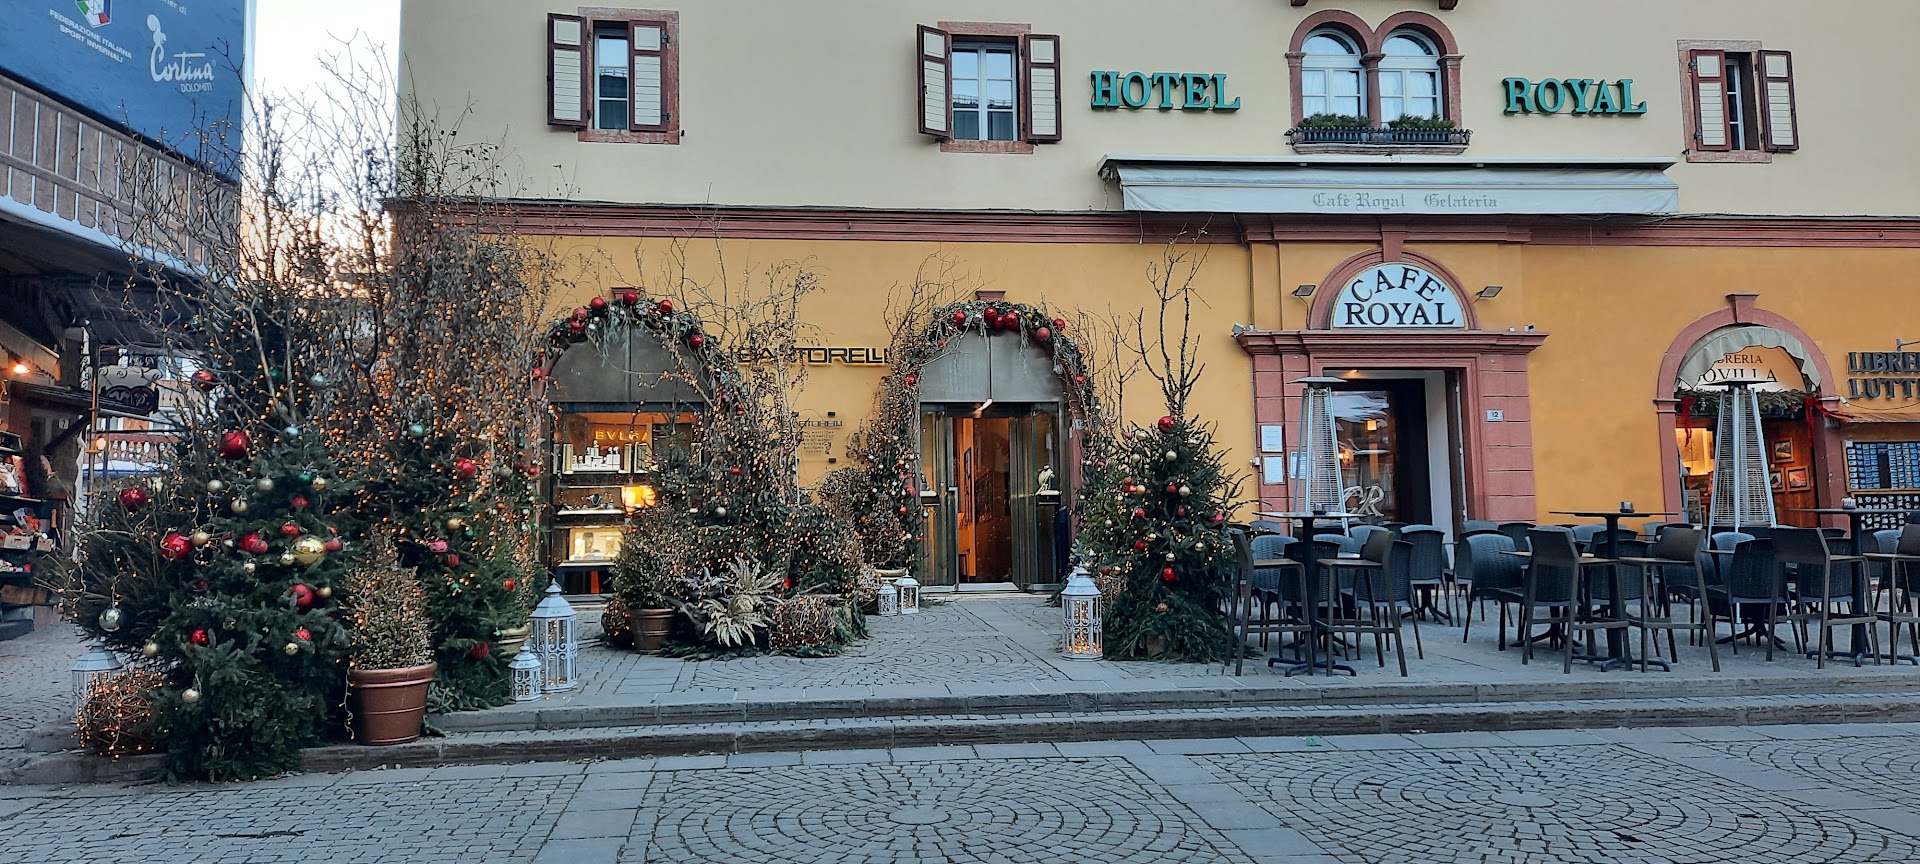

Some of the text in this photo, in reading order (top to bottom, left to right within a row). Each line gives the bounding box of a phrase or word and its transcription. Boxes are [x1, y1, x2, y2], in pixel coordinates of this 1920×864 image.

[49, 9, 133, 60] FEDERAZIONE ITALIANA
[59, 24, 124, 64] SPORT INVERNALI
[150, 45, 215, 82] Cortina
[180, 82, 213, 93] DOLOMITI
[1091, 70, 1241, 112] HOTEL
[1502, 77, 1648, 117] ROYAL
[1355, 192, 1406, 212] Royal
[1424, 193, 1498, 208] Gelateria
[1344, 302, 1455, 326] ROYAL
[1848, 352, 1920, 373] LIBRE
[1702, 368, 1778, 383] OVILLA
[1848, 378, 1920, 400] LUTT
